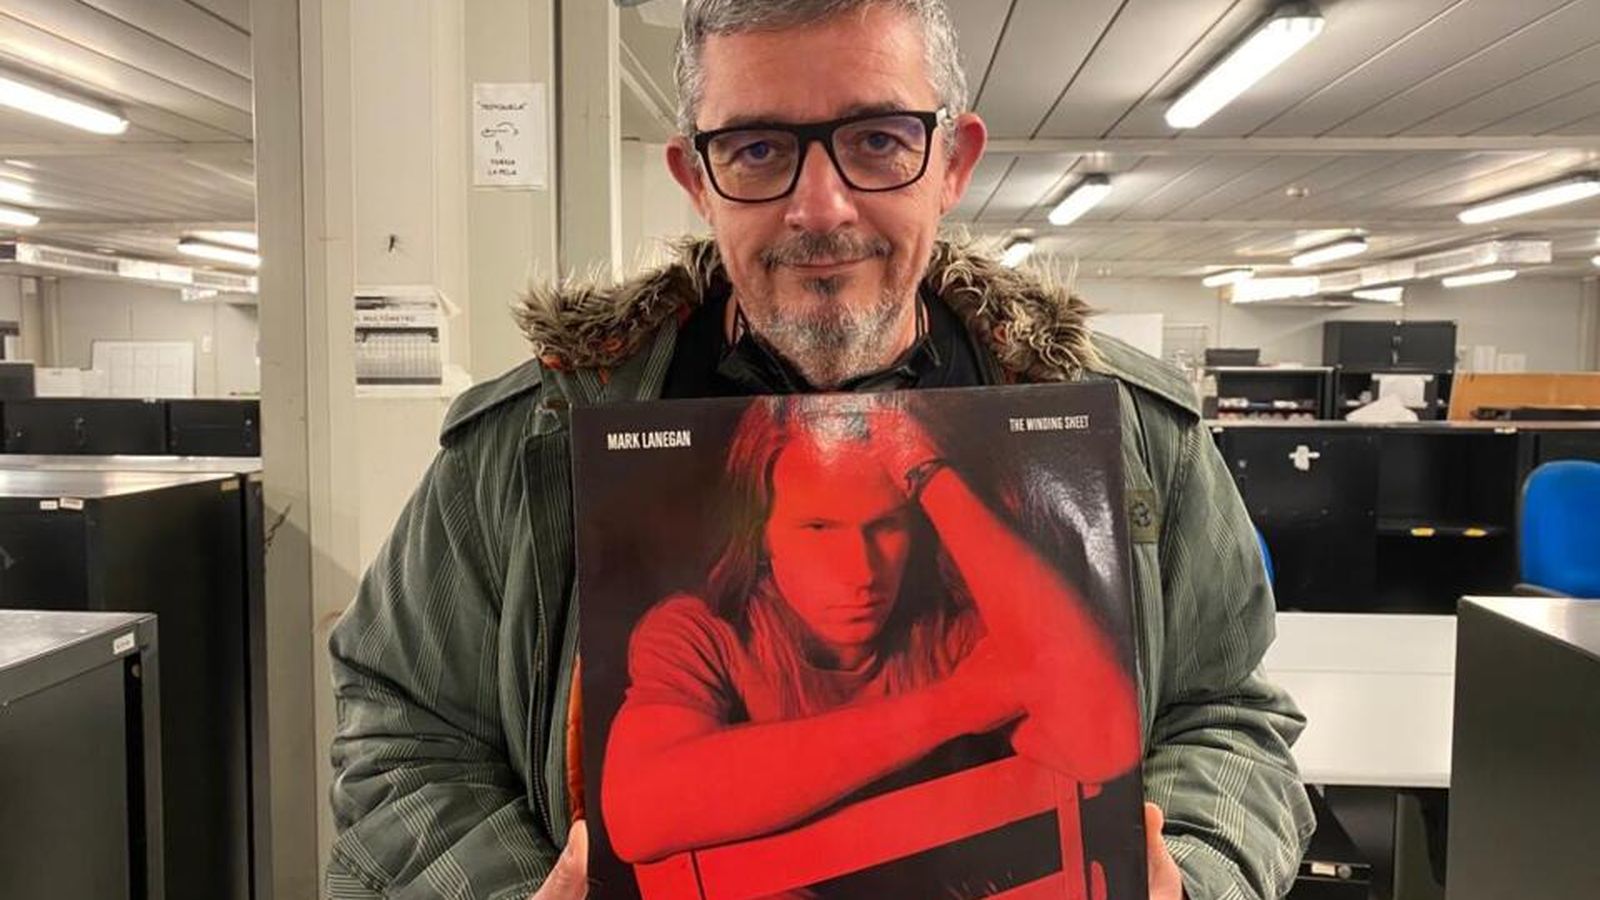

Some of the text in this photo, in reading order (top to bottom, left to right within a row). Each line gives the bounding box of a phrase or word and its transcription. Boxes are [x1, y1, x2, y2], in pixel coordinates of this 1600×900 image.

[1009, 414, 1090, 433] THE WINDING SHEET
[607, 430, 691, 450] MARK LANEGAN
